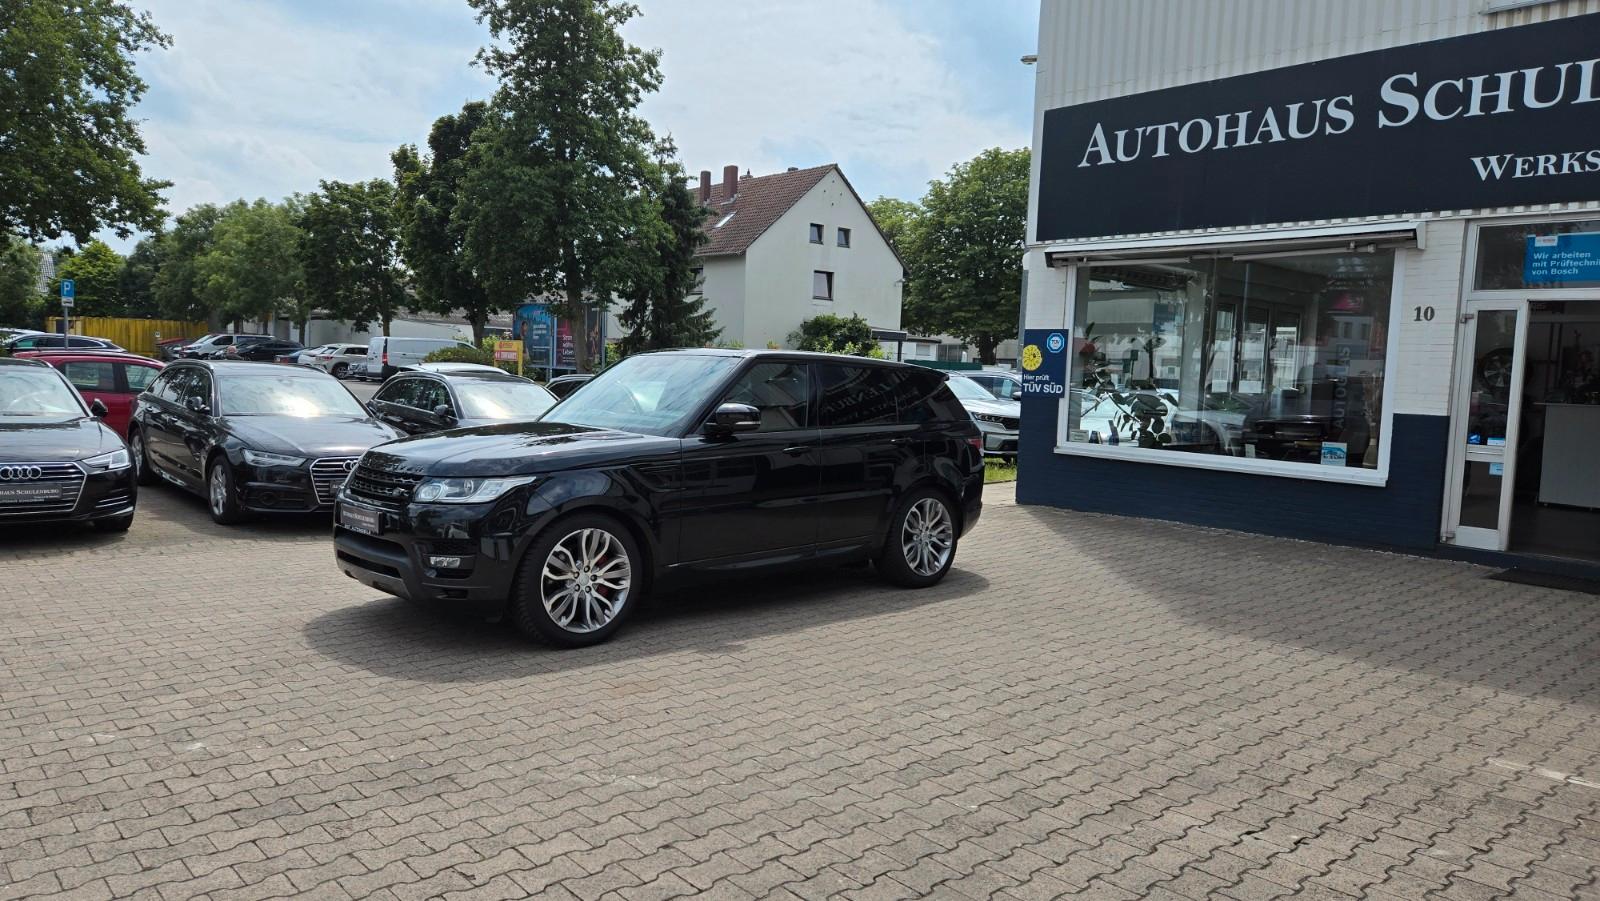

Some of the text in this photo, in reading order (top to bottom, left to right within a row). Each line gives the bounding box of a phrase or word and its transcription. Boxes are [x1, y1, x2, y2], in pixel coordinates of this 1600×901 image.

[1077, 94, 1354, 169] AUTOHAUS
[1552, 251, 1591, 259] arbeiten
[1550, 259, 1600, 267] Prüftechni
[1550, 267, 1579, 275] Bosch
[64, 282, 71, 295] P
[1413, 305, 1436, 322] 10
[1023, 381, 1063, 394] TÜV SÜD
